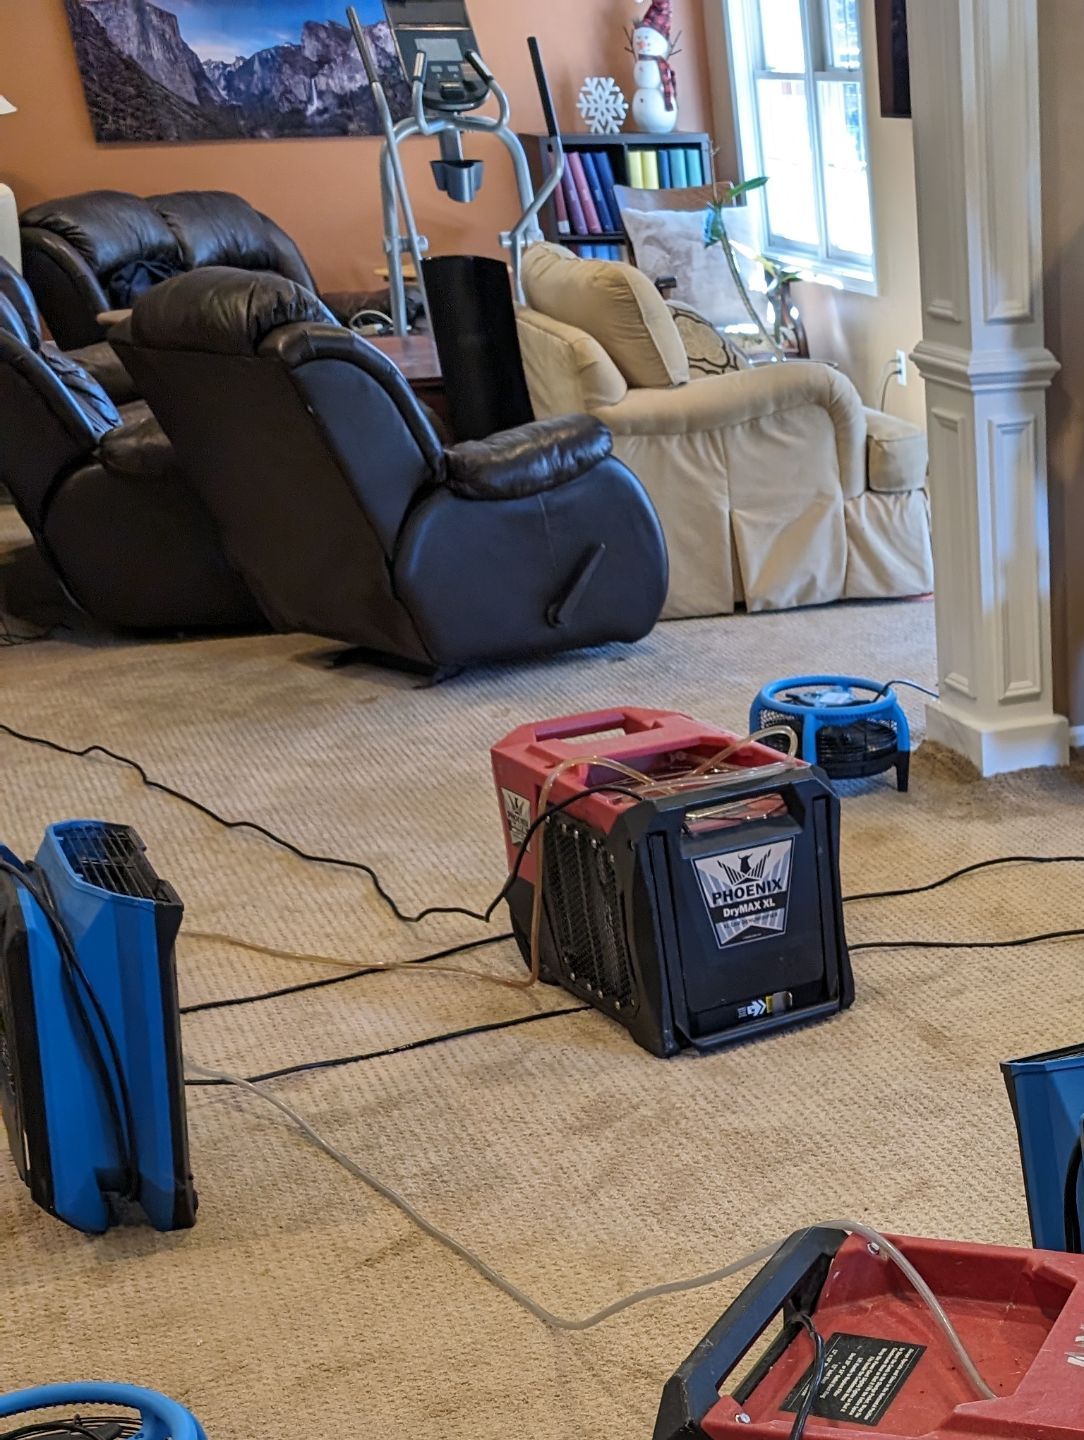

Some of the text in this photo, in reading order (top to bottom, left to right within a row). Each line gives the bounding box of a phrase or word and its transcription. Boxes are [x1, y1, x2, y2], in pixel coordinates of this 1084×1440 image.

[712, 878, 782, 904] PHOENIX
[723, 898, 776, 918] DryMAX XL
